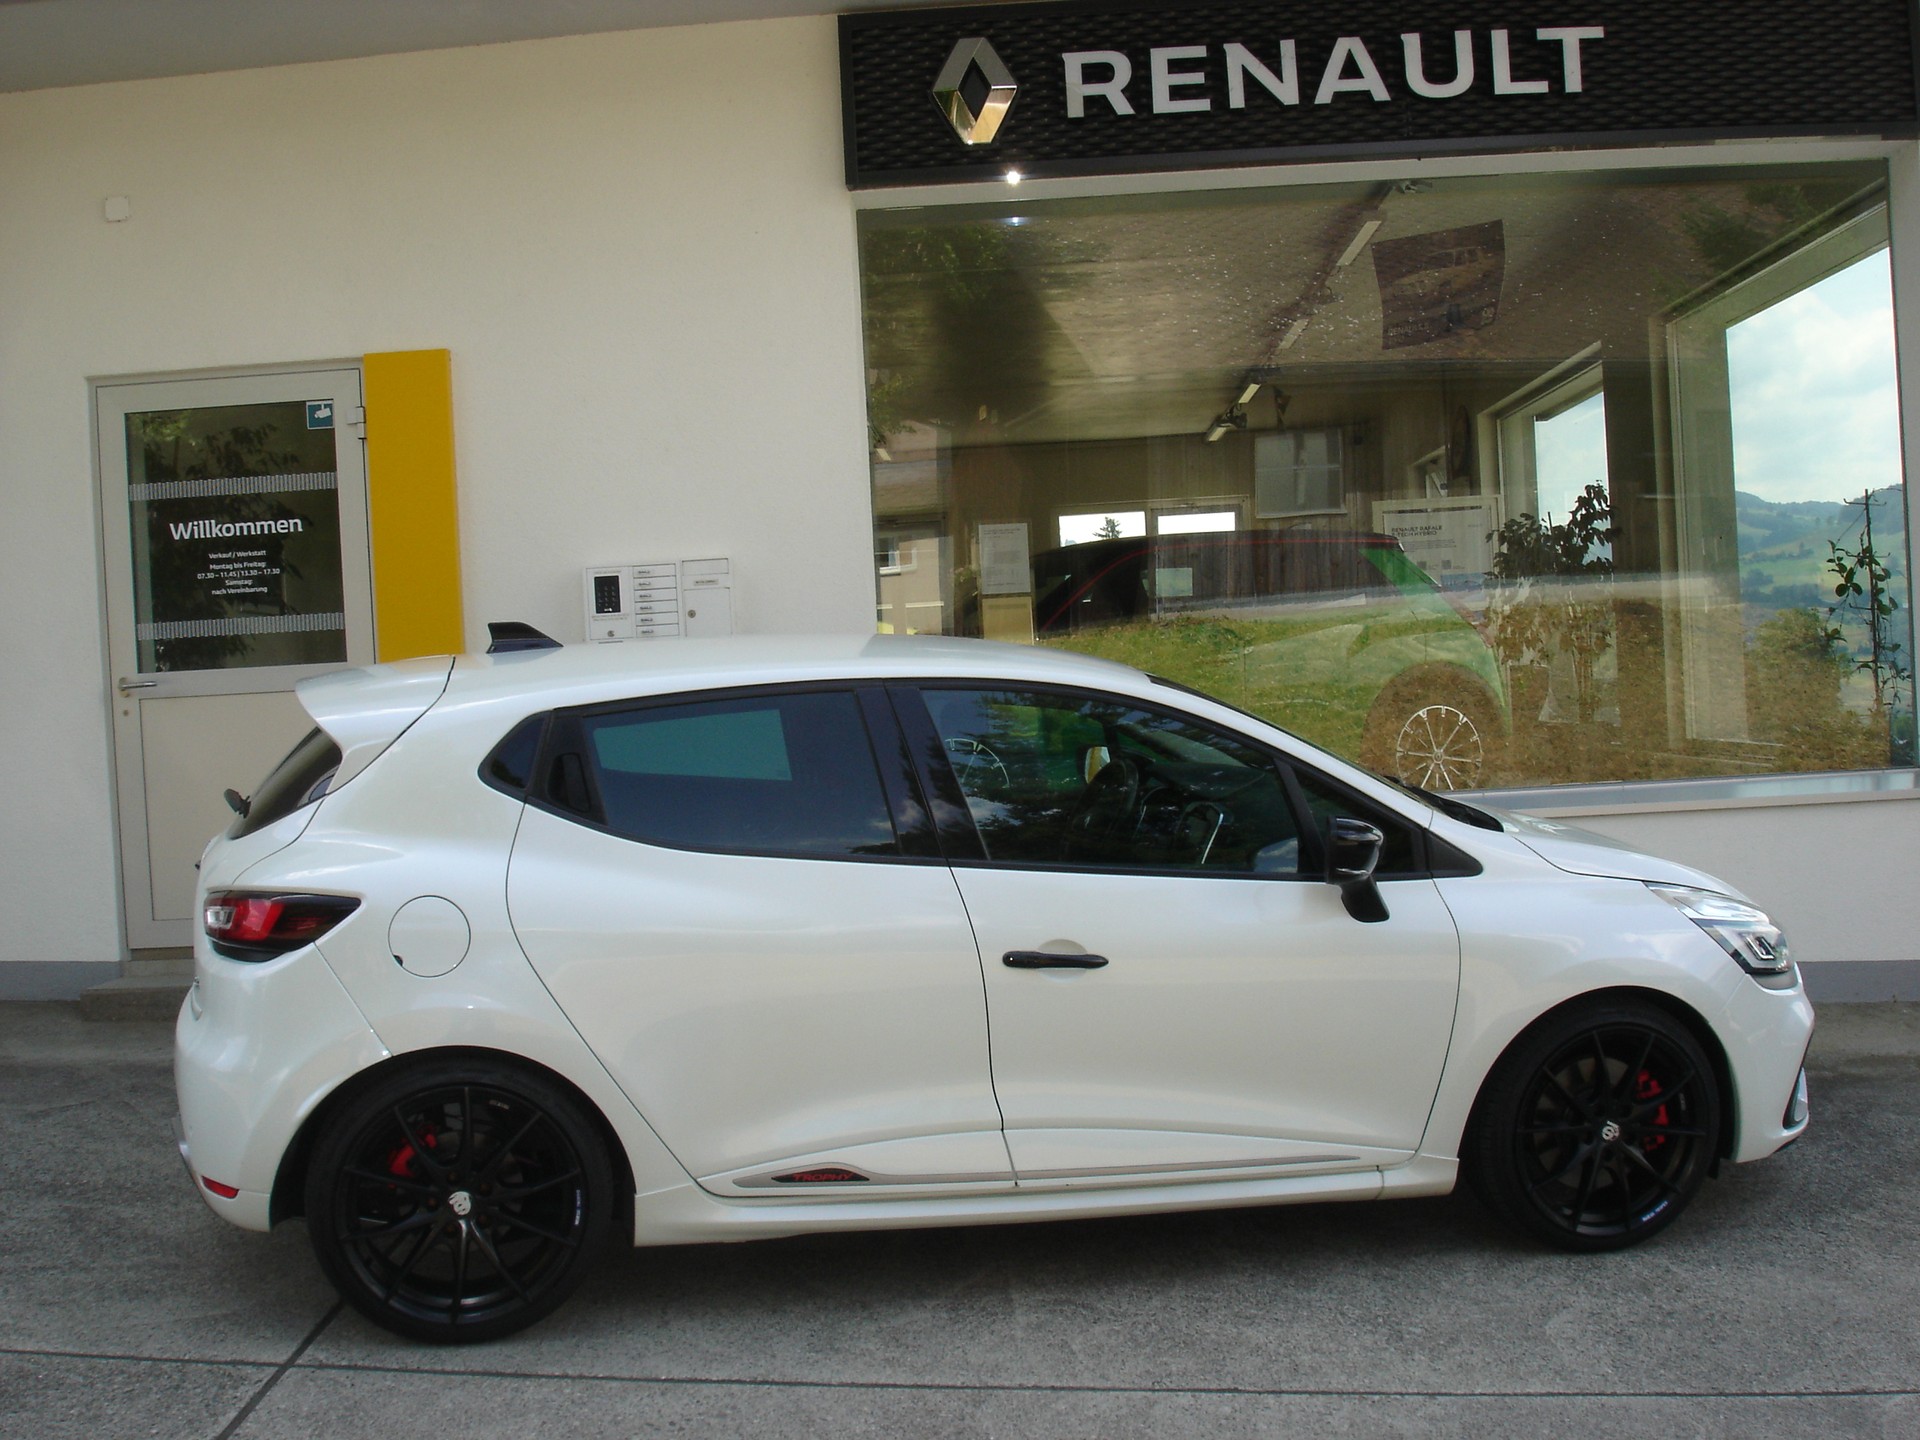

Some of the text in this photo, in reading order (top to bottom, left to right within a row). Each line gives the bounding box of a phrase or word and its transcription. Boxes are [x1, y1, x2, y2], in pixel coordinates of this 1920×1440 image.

[1061, 25, 1604, 118] RENAULT
[169, 518, 303, 540] Willkommen
[208, 551, 232, 559] Verkauf
[227, 586, 268, 594] Vereinbarung
[792, 1173, 854, 1182] TROPHY
